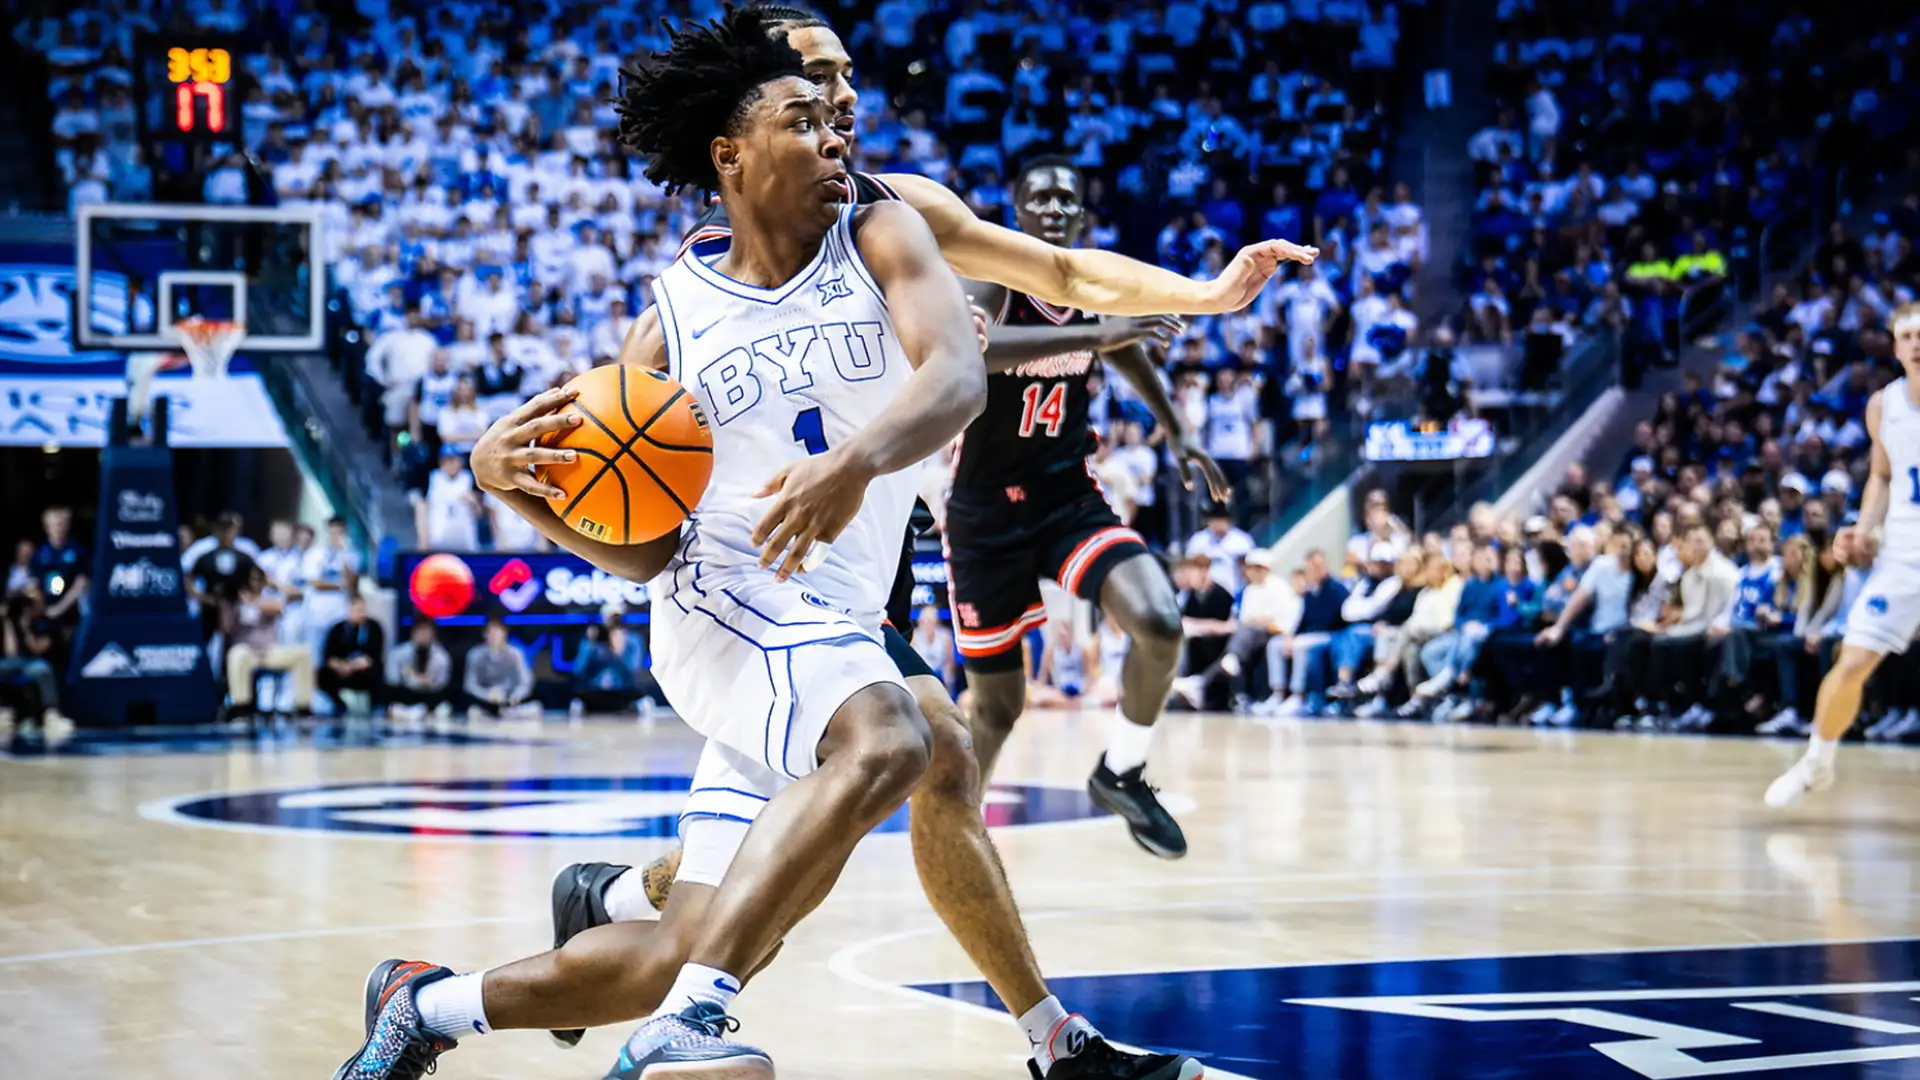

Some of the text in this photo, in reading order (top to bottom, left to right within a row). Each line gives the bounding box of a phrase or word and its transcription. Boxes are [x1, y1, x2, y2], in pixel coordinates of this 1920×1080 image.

[176, 83, 225, 132] 17
[698, 321, 885, 427] BYU
[792, 406, 830, 456] 1
[1018, 382, 1067, 437] 14
